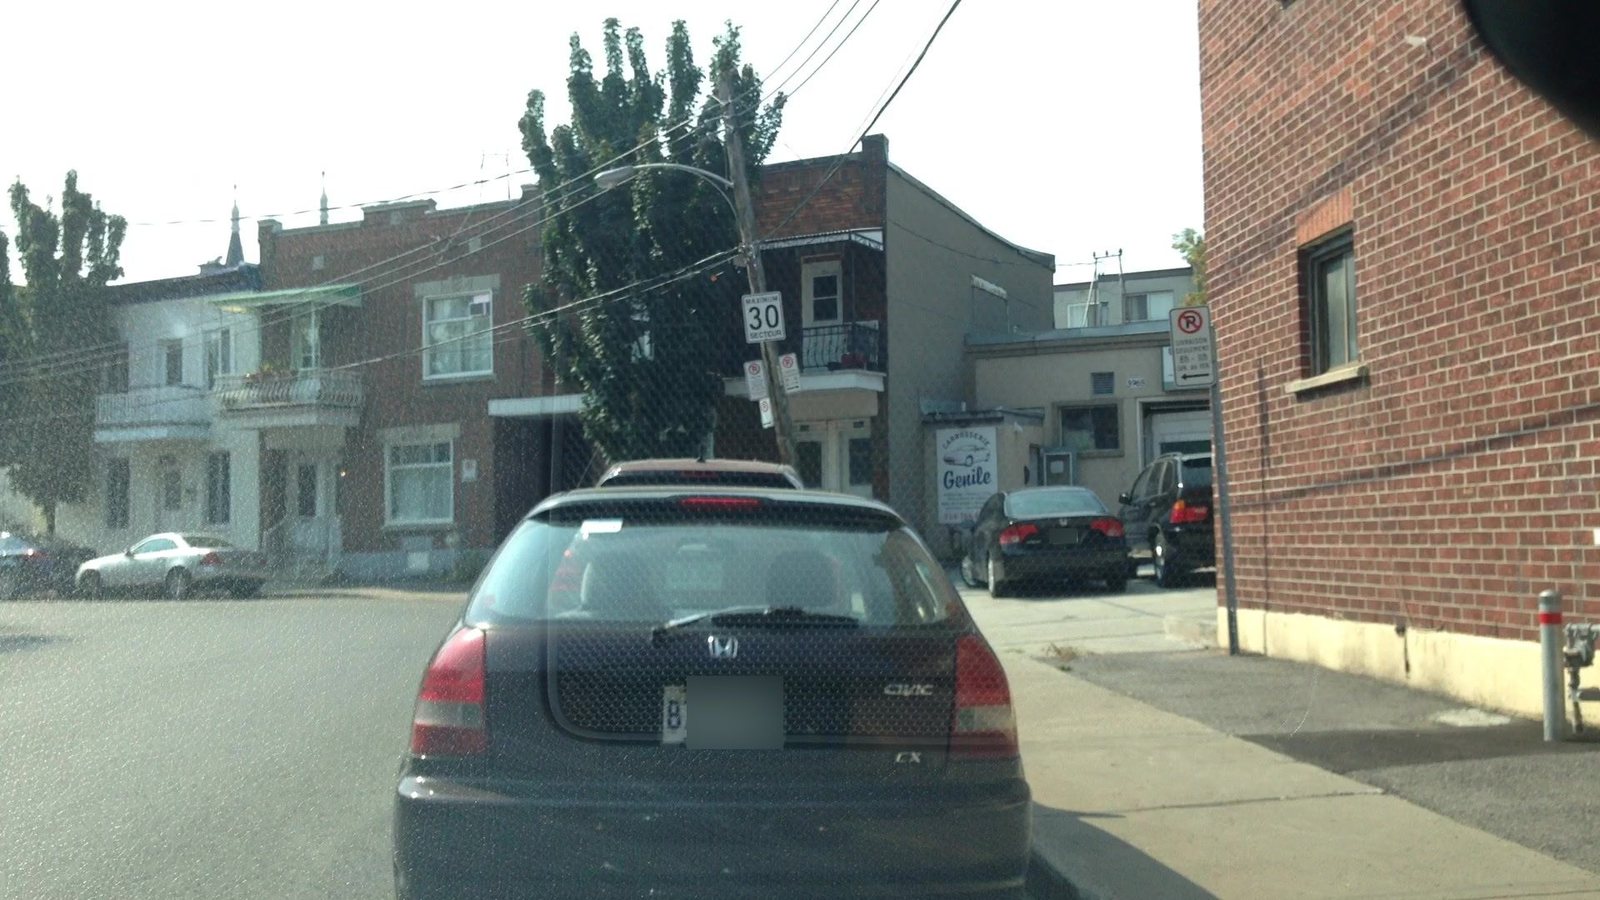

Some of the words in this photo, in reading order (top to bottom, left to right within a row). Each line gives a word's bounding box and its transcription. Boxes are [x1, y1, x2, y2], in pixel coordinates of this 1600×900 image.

[745, 295, 778, 304] MAXIMUM
[749, 304, 779, 330] 30
[750, 329, 782, 339] SECTEUR
[942, 431, 990, 449] CARROSSERIE
[944, 466, 991, 489] Genile
[884, 684, 934, 697] CIVIC
